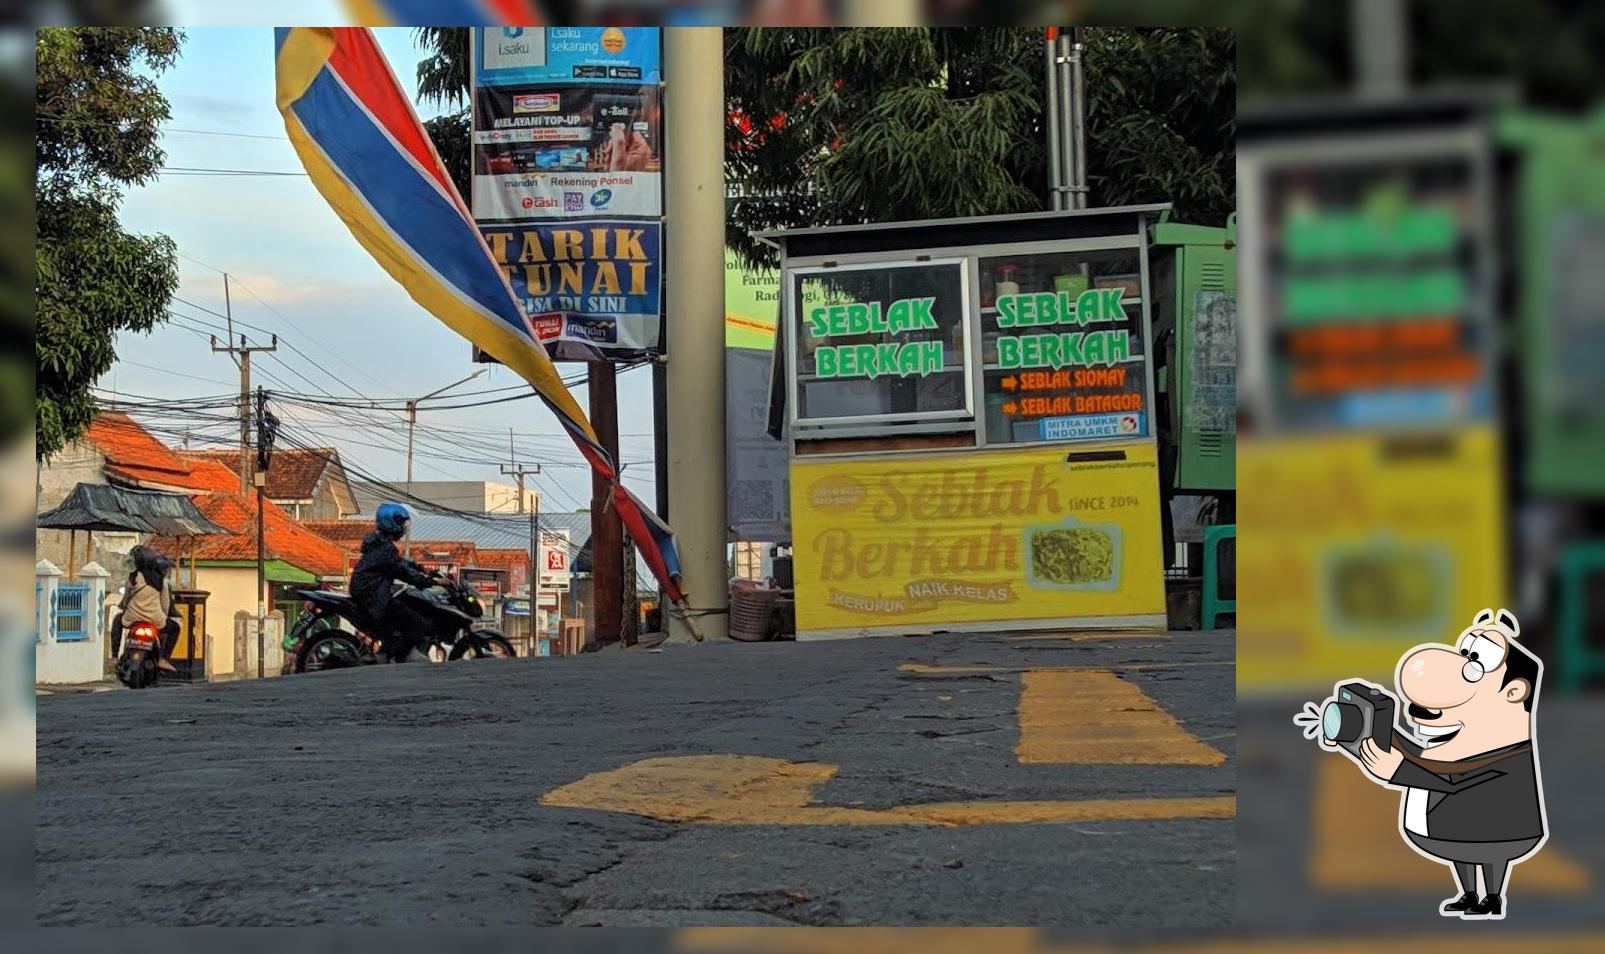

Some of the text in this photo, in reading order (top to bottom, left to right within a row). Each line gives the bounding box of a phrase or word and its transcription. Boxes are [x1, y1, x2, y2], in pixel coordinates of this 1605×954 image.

[498, 43, 529, 56] i.saku
[551, 41, 599, 55] sekarang
[494, 115, 580, 128] MELAYANI TOP-UP
[551, 176, 633, 189] Rekening Ponsel
[565, 192, 583, 201] PAY
[565, 201, 583, 211] PRO
[485, 228, 648, 263] TARIK
[521, 296, 627, 313] ISA DI SINI
[995, 287, 1129, 328] SEBLAK
[810, 296, 939, 338] SEBLAK
[996, 330, 1130, 370] BERKAH
[814, 340, 944, 380] BERKAH
[1020, 368, 1126, 390] SEBLAK SIOMAY
[1021, 393, 1143, 416] SEBLAK BATAGOR
[1047, 416, 1118, 429] MITRA UMKM
[1048, 425, 1119, 438] INDOMARET
[872, 464, 1062, 525] Seblak
[1110, 495, 1139, 508] 2014
[812, 522, 1021, 583] Berkah
[953, 584, 1008, 601] KELAS
[832, 593, 905, 613] KERUPUK
